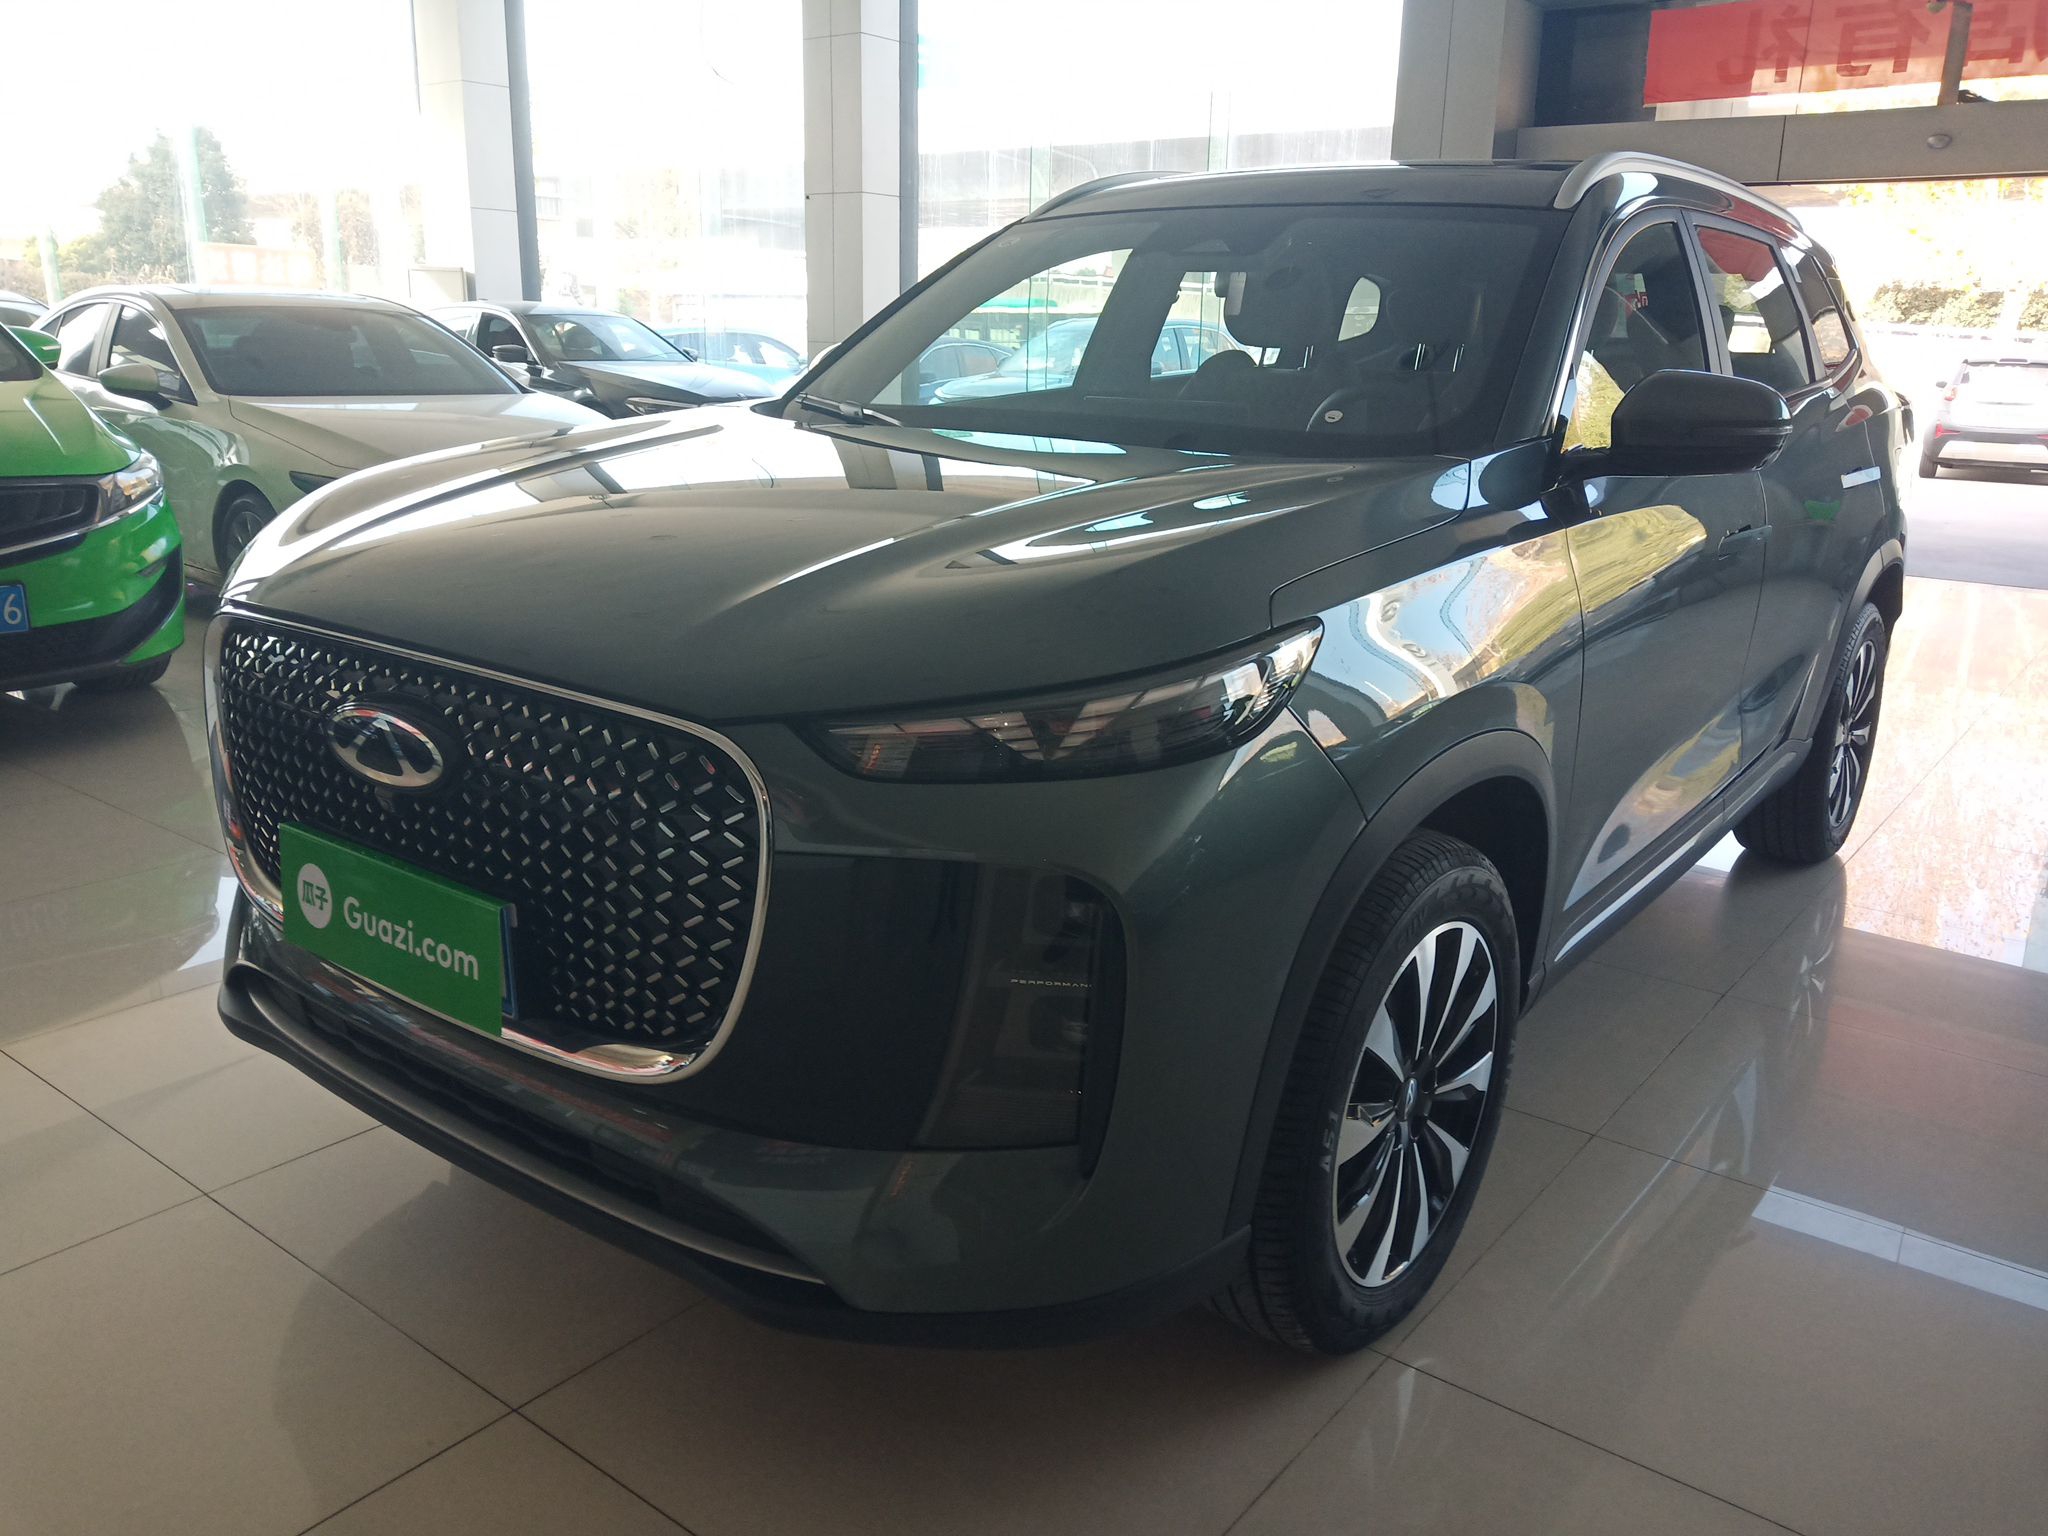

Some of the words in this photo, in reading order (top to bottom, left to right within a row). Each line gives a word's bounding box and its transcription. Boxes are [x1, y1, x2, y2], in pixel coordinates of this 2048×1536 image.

[3, 593, 22, 625] 6
[301, 879, 329, 911] 瓜子
[343, 896, 479, 981] Guazi.com
[1009, 977, 1093, 989] PERFORMAN
